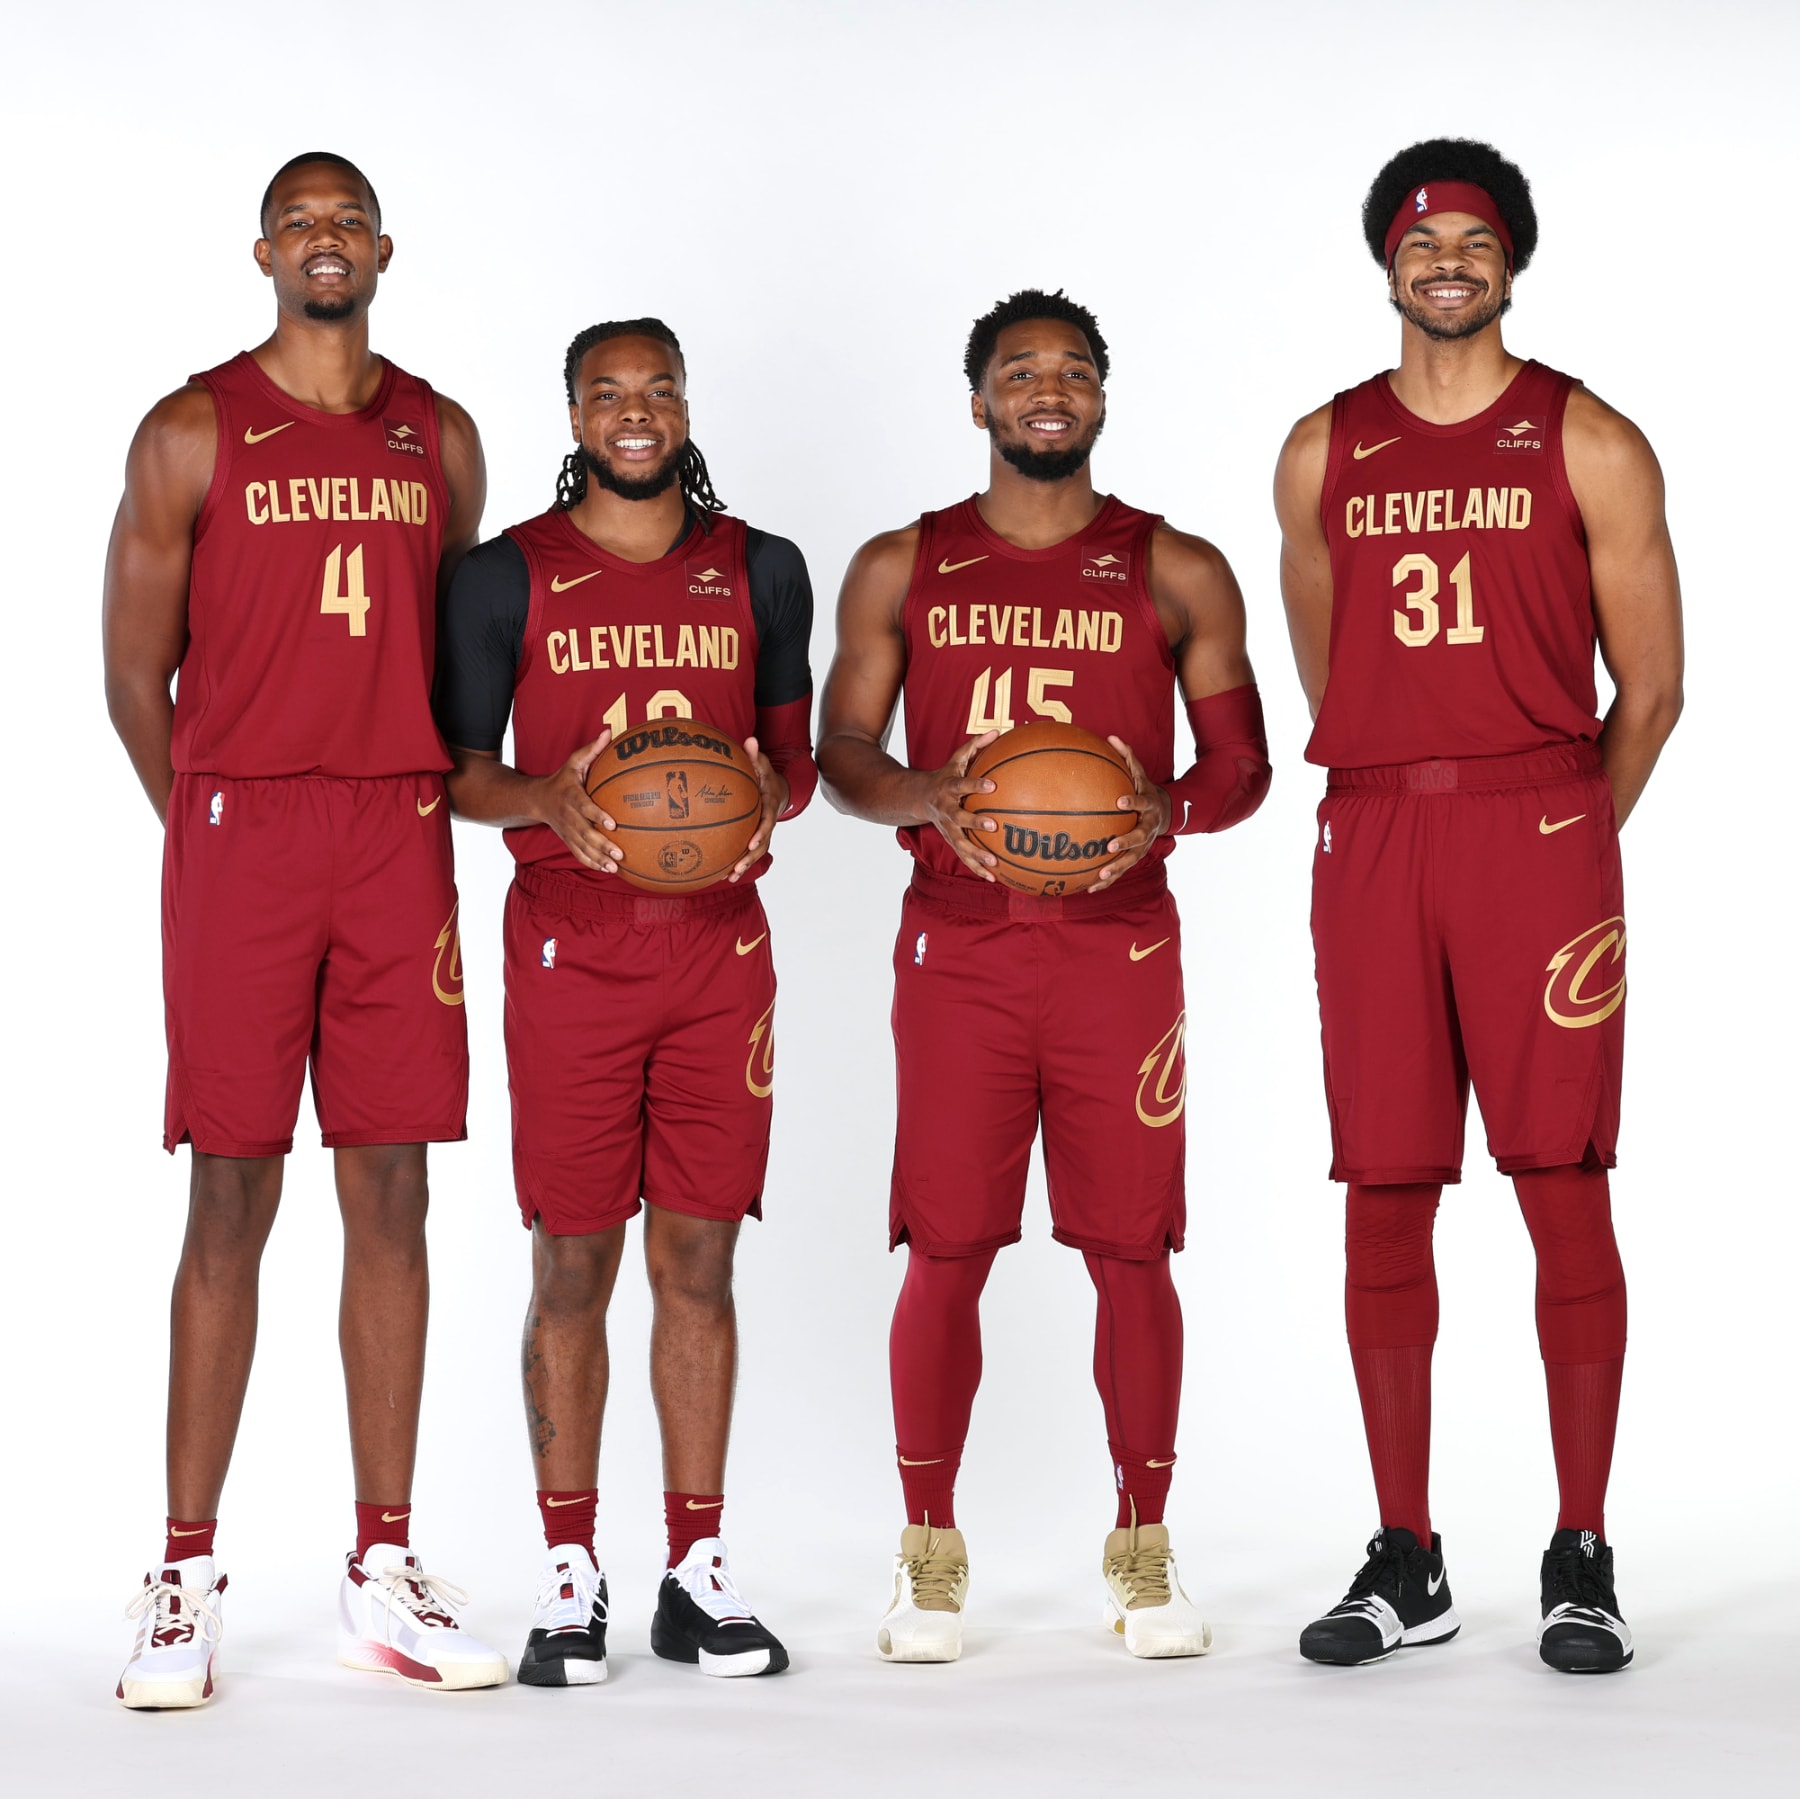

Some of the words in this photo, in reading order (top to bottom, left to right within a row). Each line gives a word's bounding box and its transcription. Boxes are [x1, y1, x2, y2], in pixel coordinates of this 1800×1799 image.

[387, 440, 424, 454] CLIFFS
[1496, 439, 1541, 450] CLIFFS
[245, 477, 427, 526] CLEVELAND
[1345, 487, 1533, 539] CLEVELAND
[319, 543, 371, 637] 4
[688, 584, 731, 597] CLIFFS
[1082, 568, 1126, 581] CLIFFS
[1392, 550, 1485, 648] 31
[546, 624, 739, 675] CLEVELAND
[927, 604, 1123, 653] CLEVELAND
[965, 666, 1074, 736] 45
[613, 726, 733, 761] Wilson
